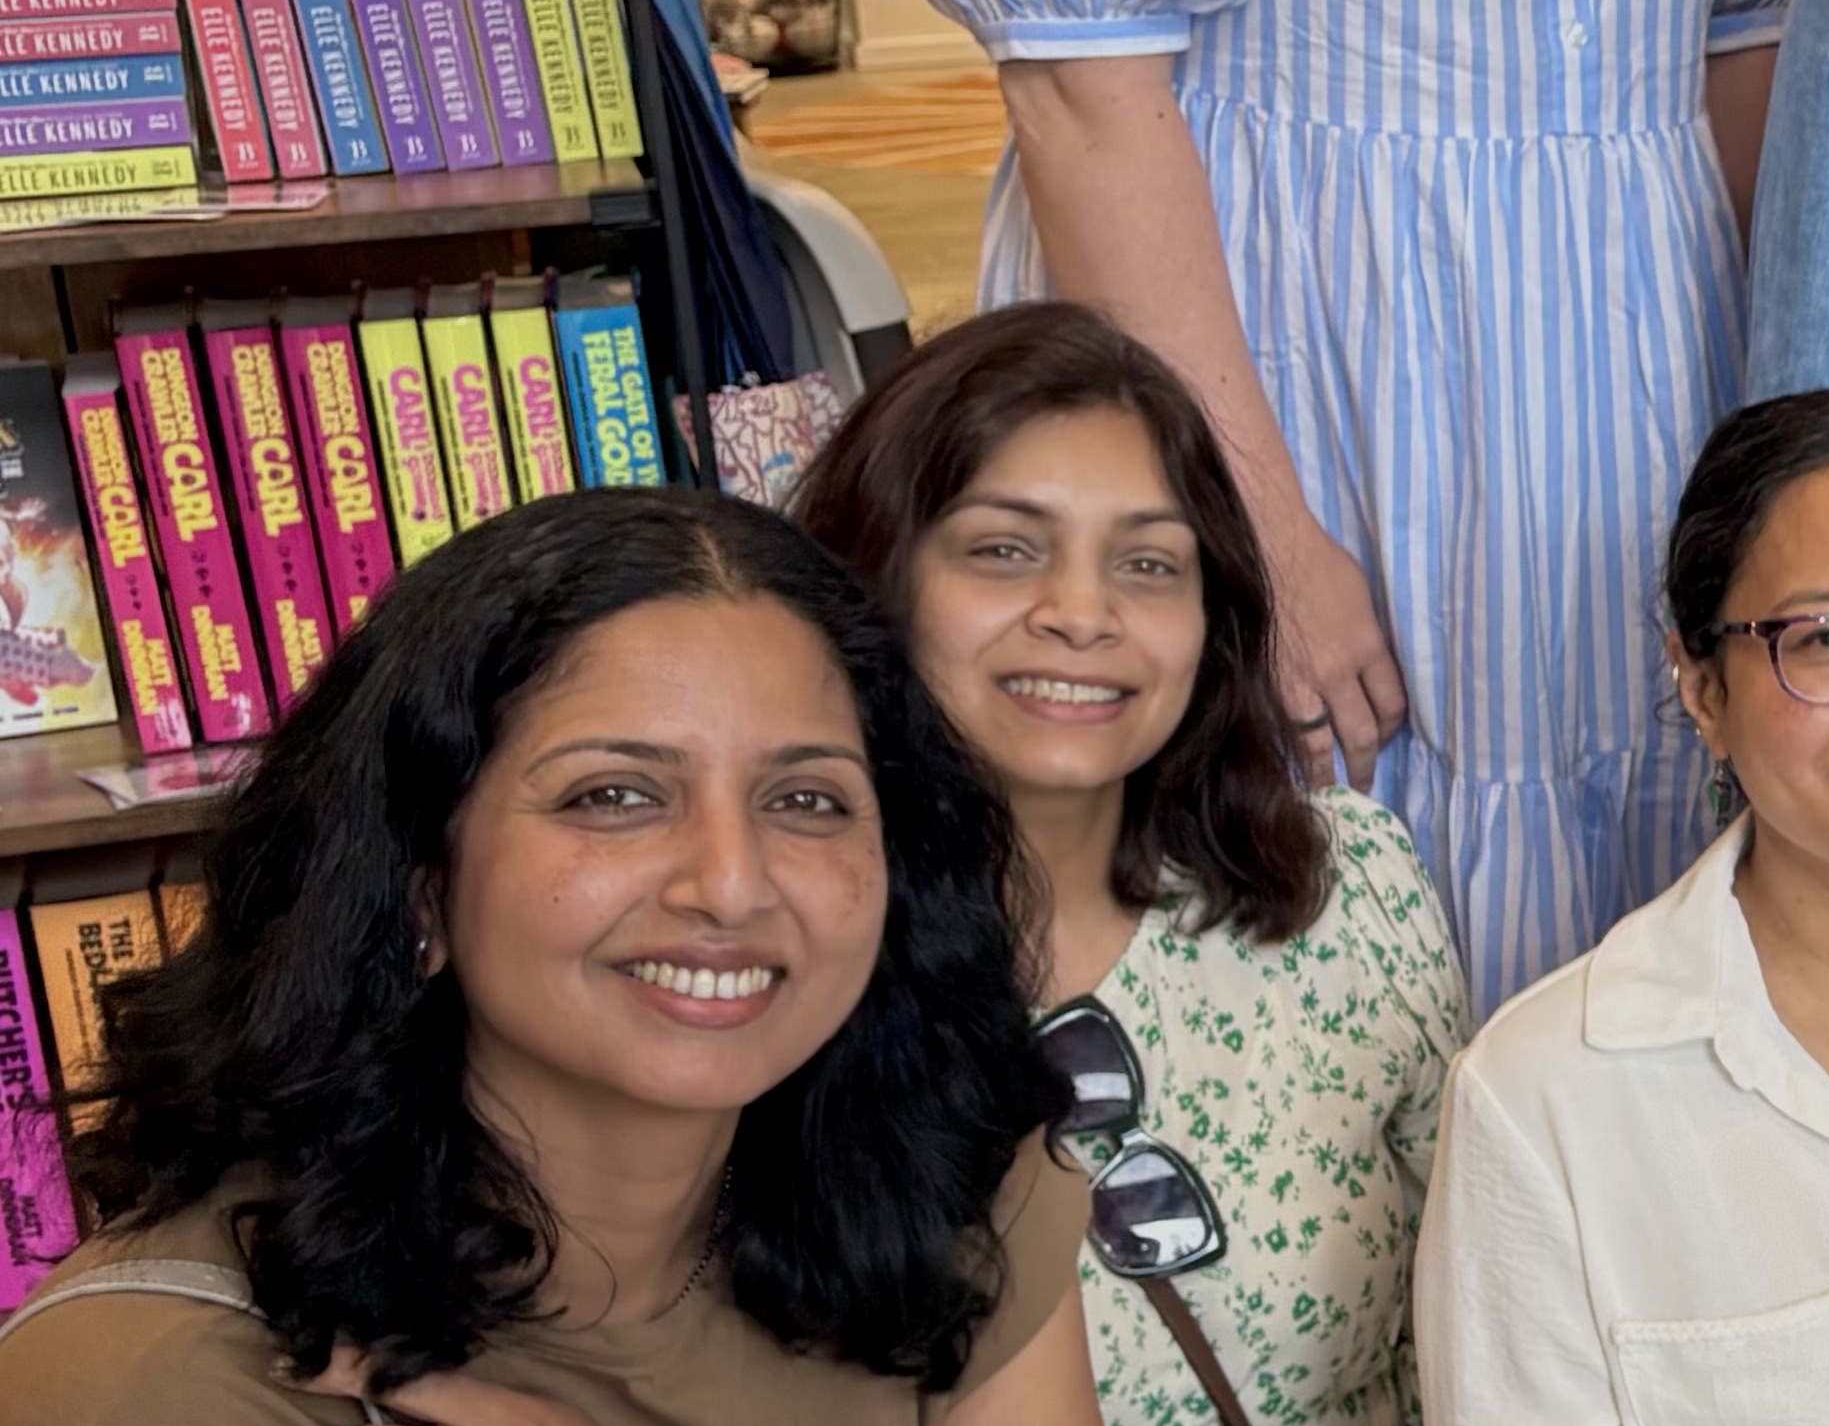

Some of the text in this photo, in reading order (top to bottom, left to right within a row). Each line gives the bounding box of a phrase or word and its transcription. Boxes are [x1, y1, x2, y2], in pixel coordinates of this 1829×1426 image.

[1, 69, 129, 98] LLE KENNEDY
[34, 28, 123, 53] KENNEDY
[201, 7, 247, 131] ELLE KENNEDY
[252, 7, 299, 131] ELLE KENNEDY
[310, 5, 358, 129] ELLE KENNEDY
[366, 3, 415, 125] ELLE KENNEDY
[422, 0, 468, 123] ELLE KENNEDY
[491, 42, 526, 119] KENNEDY
[541, 38, 574, 114] KENNEDY
[588, 34, 619, 111] KENNEDY
[0, 118, 133, 146] LLE KENNEDY
[48, 164, 137, 189] KENNEDY
[140, 349, 180, 446] CRAWLER
[162, 346, 200, 441] DUNGEON
[230, 344, 268, 441] CRAWLER
[252, 342, 287, 438] DUNGEON
[306, 341, 343, 438] CRAWLER
[326, 340, 361, 436] DUNGEON
[581, 329, 634, 487] FERAL GOD
[613, 325, 656, 461] THE GATE OF
[80, 408, 115, 488] CRAWLER
[97, 405, 129, 485] DUNGEON
[162, 441, 218, 543] CARL
[250, 436, 304, 539] CARL
[324, 434, 377, 535] CARL
[99, 484, 147, 569] CARL
[143, 638, 173, 687] MATT
[190, 604, 230, 702] DINNIMAN
[214, 623, 242, 673] MATT
[297, 617, 323, 667] MATT
[77, 922, 118, 979] BEDL
[108, 919, 135, 961] THE
